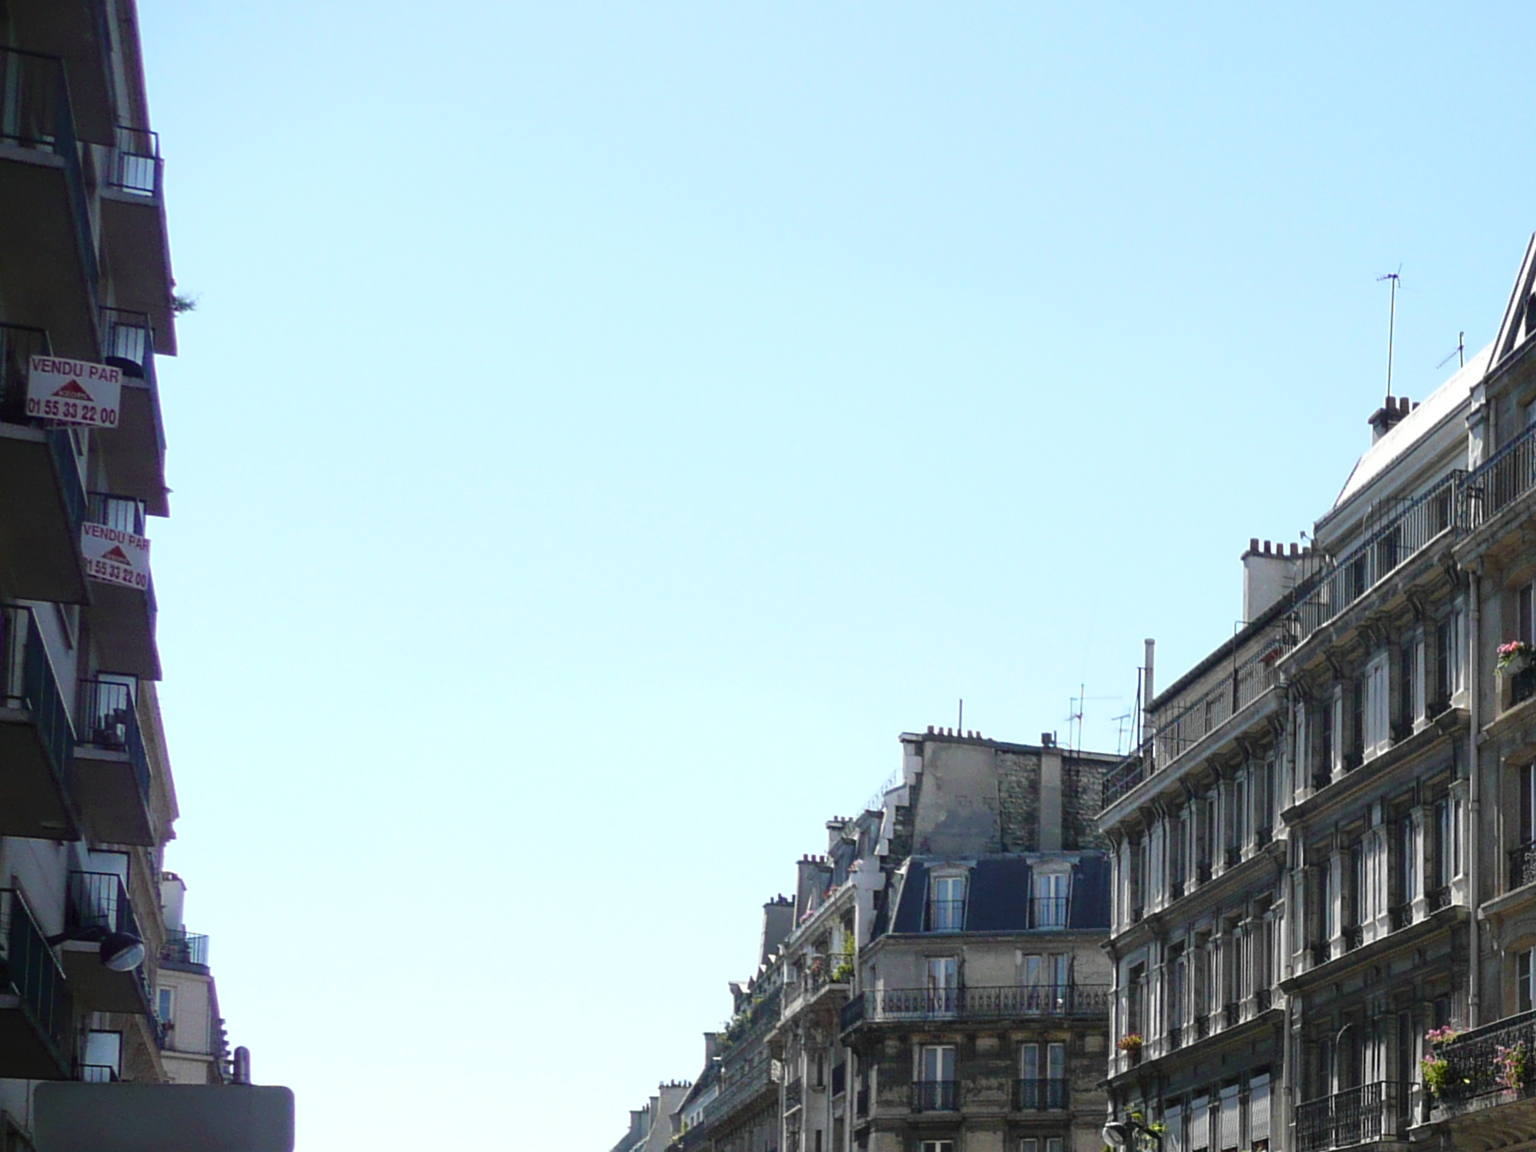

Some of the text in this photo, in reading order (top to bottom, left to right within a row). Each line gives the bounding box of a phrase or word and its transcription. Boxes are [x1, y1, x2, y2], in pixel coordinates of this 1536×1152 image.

[32, 357, 119, 383] VENDU PAR
[28, 398, 40, 414] 01
[44, 399, 59, 416] 55
[63, 402, 78, 418] 33
[82, 405, 97, 422] 22
[101, 407, 116, 425] 00
[83, 524, 125, 543] VENDU
[95, 561, 107, 575] 55
[109, 563, 120, 579] 33
[123, 567, 133, 583] 22
[135, 573, 147, 587] 00
